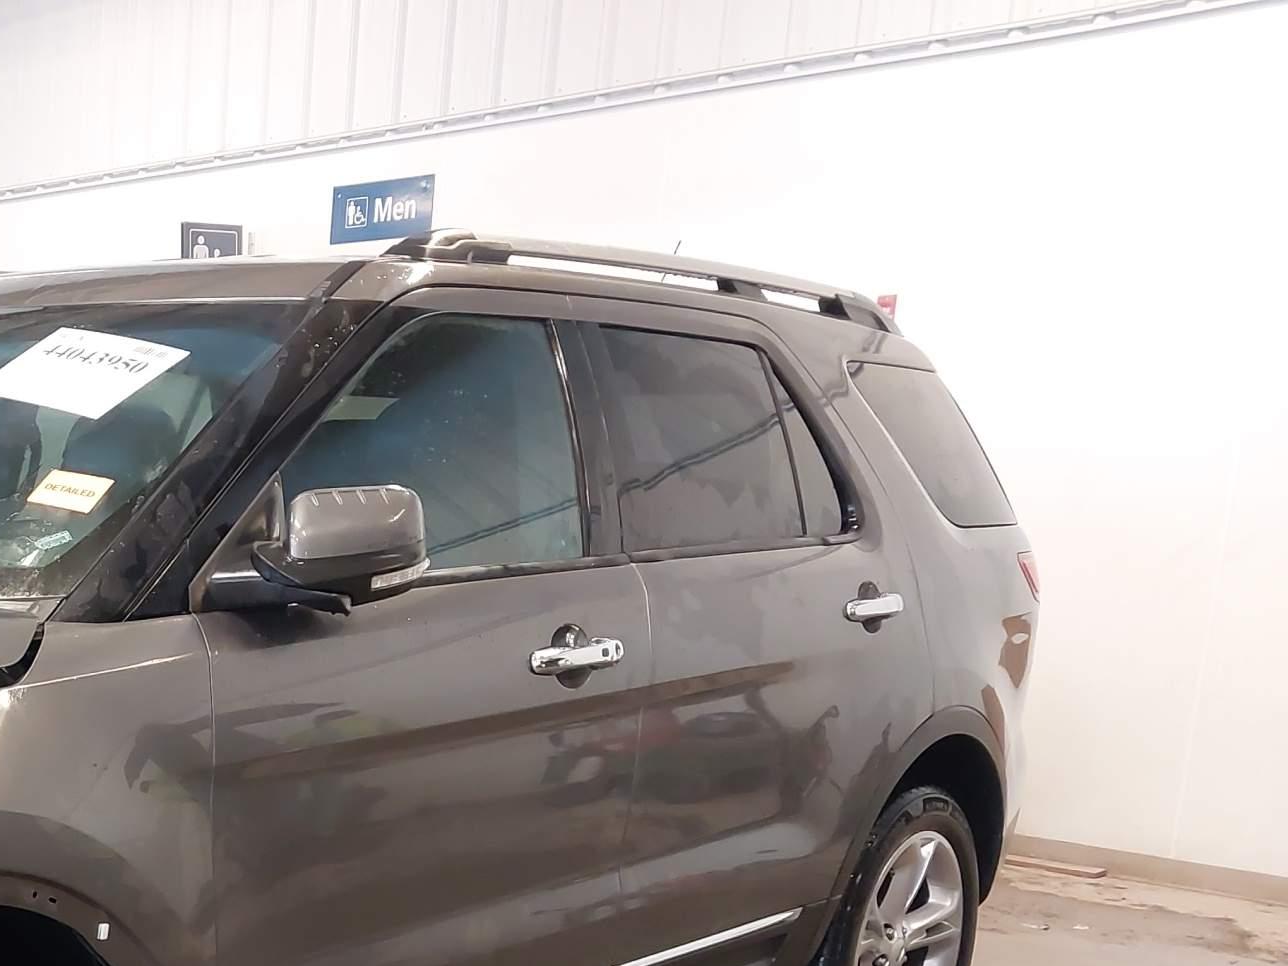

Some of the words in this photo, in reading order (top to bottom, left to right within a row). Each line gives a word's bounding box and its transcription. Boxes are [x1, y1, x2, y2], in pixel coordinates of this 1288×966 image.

[373, 196, 416, 223] Men
[44, 344, 149, 374] 44043950
[44, 483, 96, 498] DETAILED
